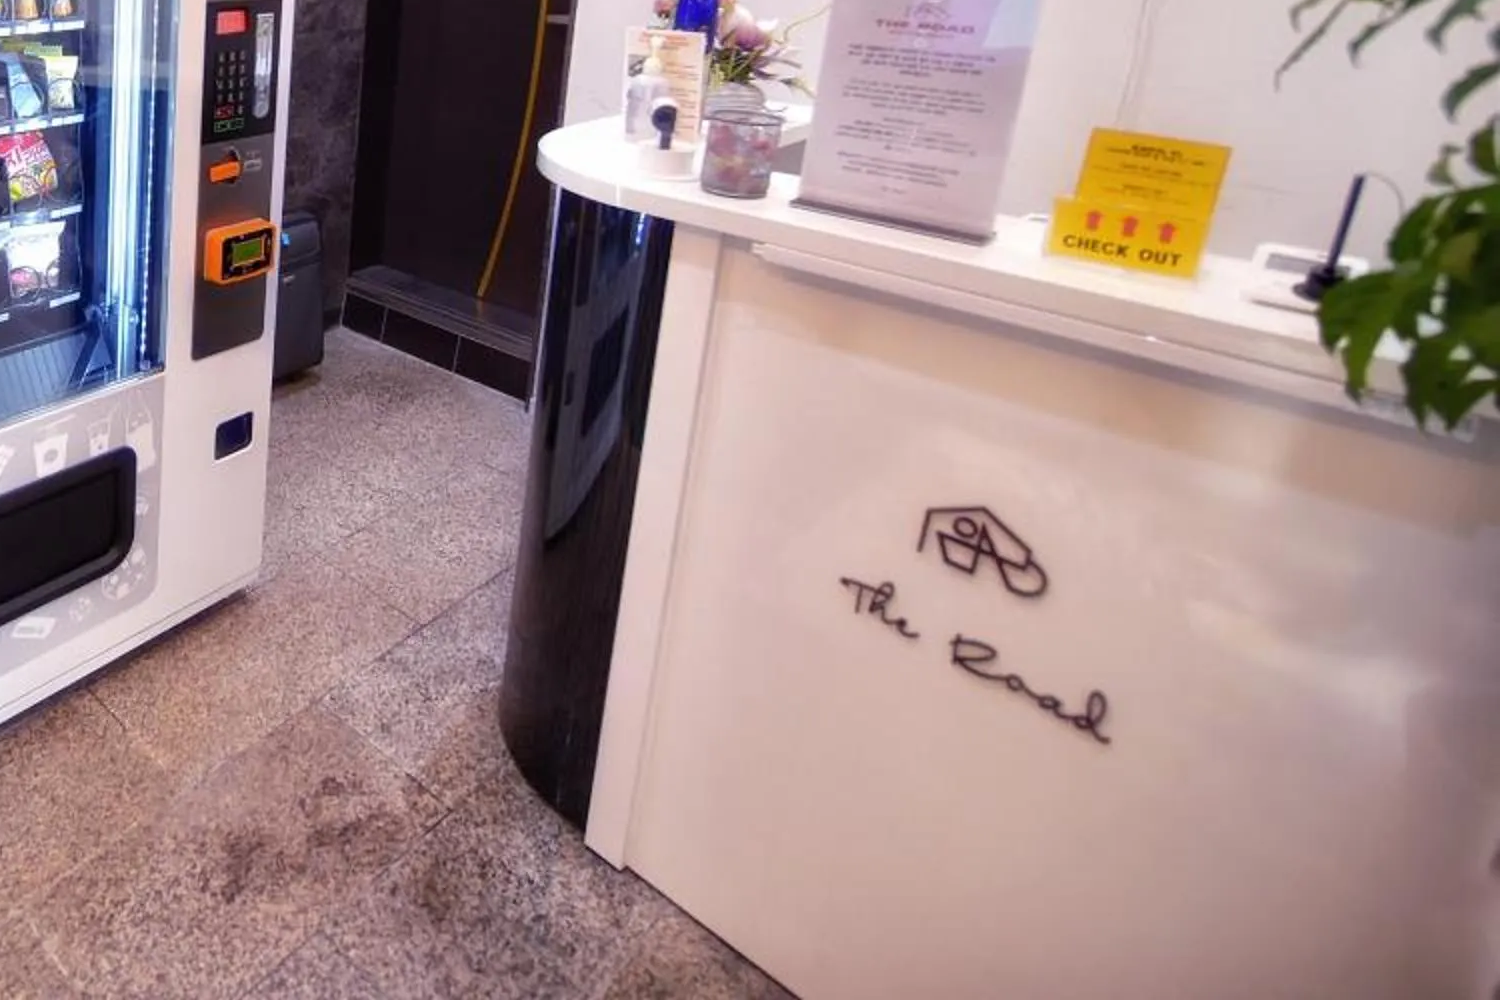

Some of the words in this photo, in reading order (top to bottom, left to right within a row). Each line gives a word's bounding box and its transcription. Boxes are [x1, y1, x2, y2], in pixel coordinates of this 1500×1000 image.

[1062, 234, 1131, 259] CHECK
[1139, 247, 1184, 268] OUT
[840, 576, 921, 639] The
[948, 632, 1112, 746] Road
